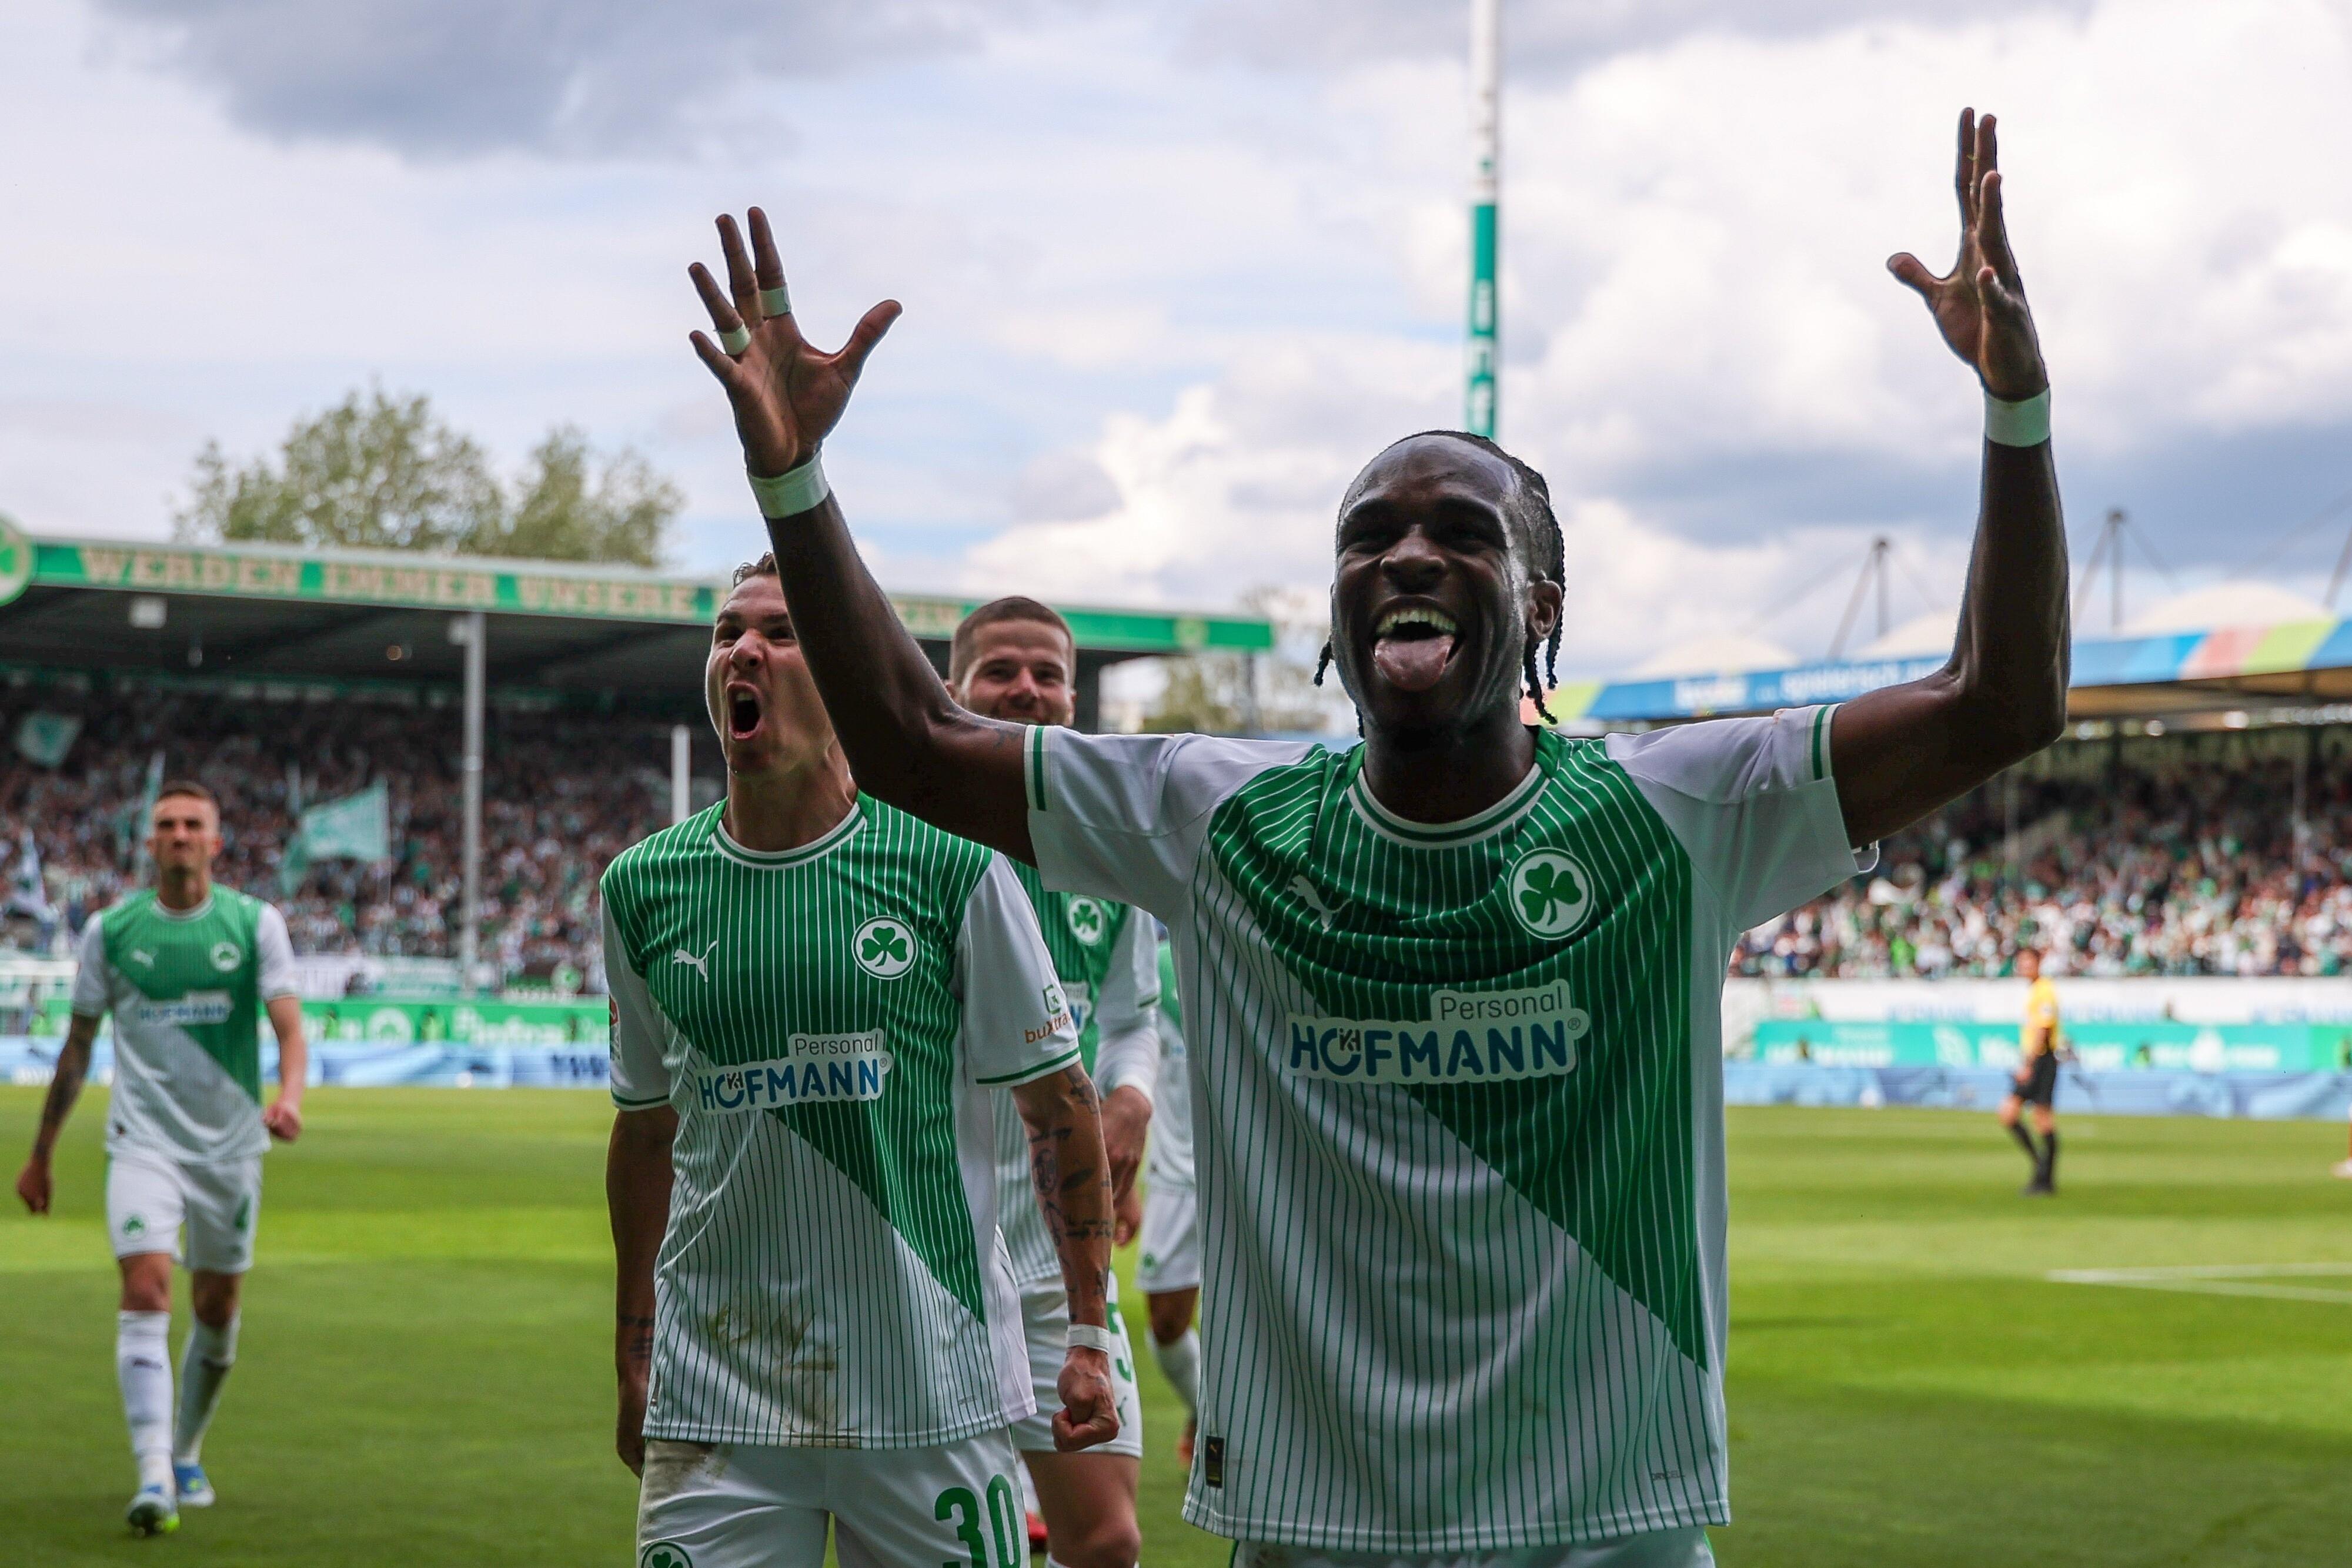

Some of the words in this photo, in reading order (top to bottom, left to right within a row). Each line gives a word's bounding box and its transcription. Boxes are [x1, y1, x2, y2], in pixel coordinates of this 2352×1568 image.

[1441, 985, 1562, 1021] Personal
[795, 1033, 880, 1057] Personal
[934, 1473, 1021, 1568] 30
